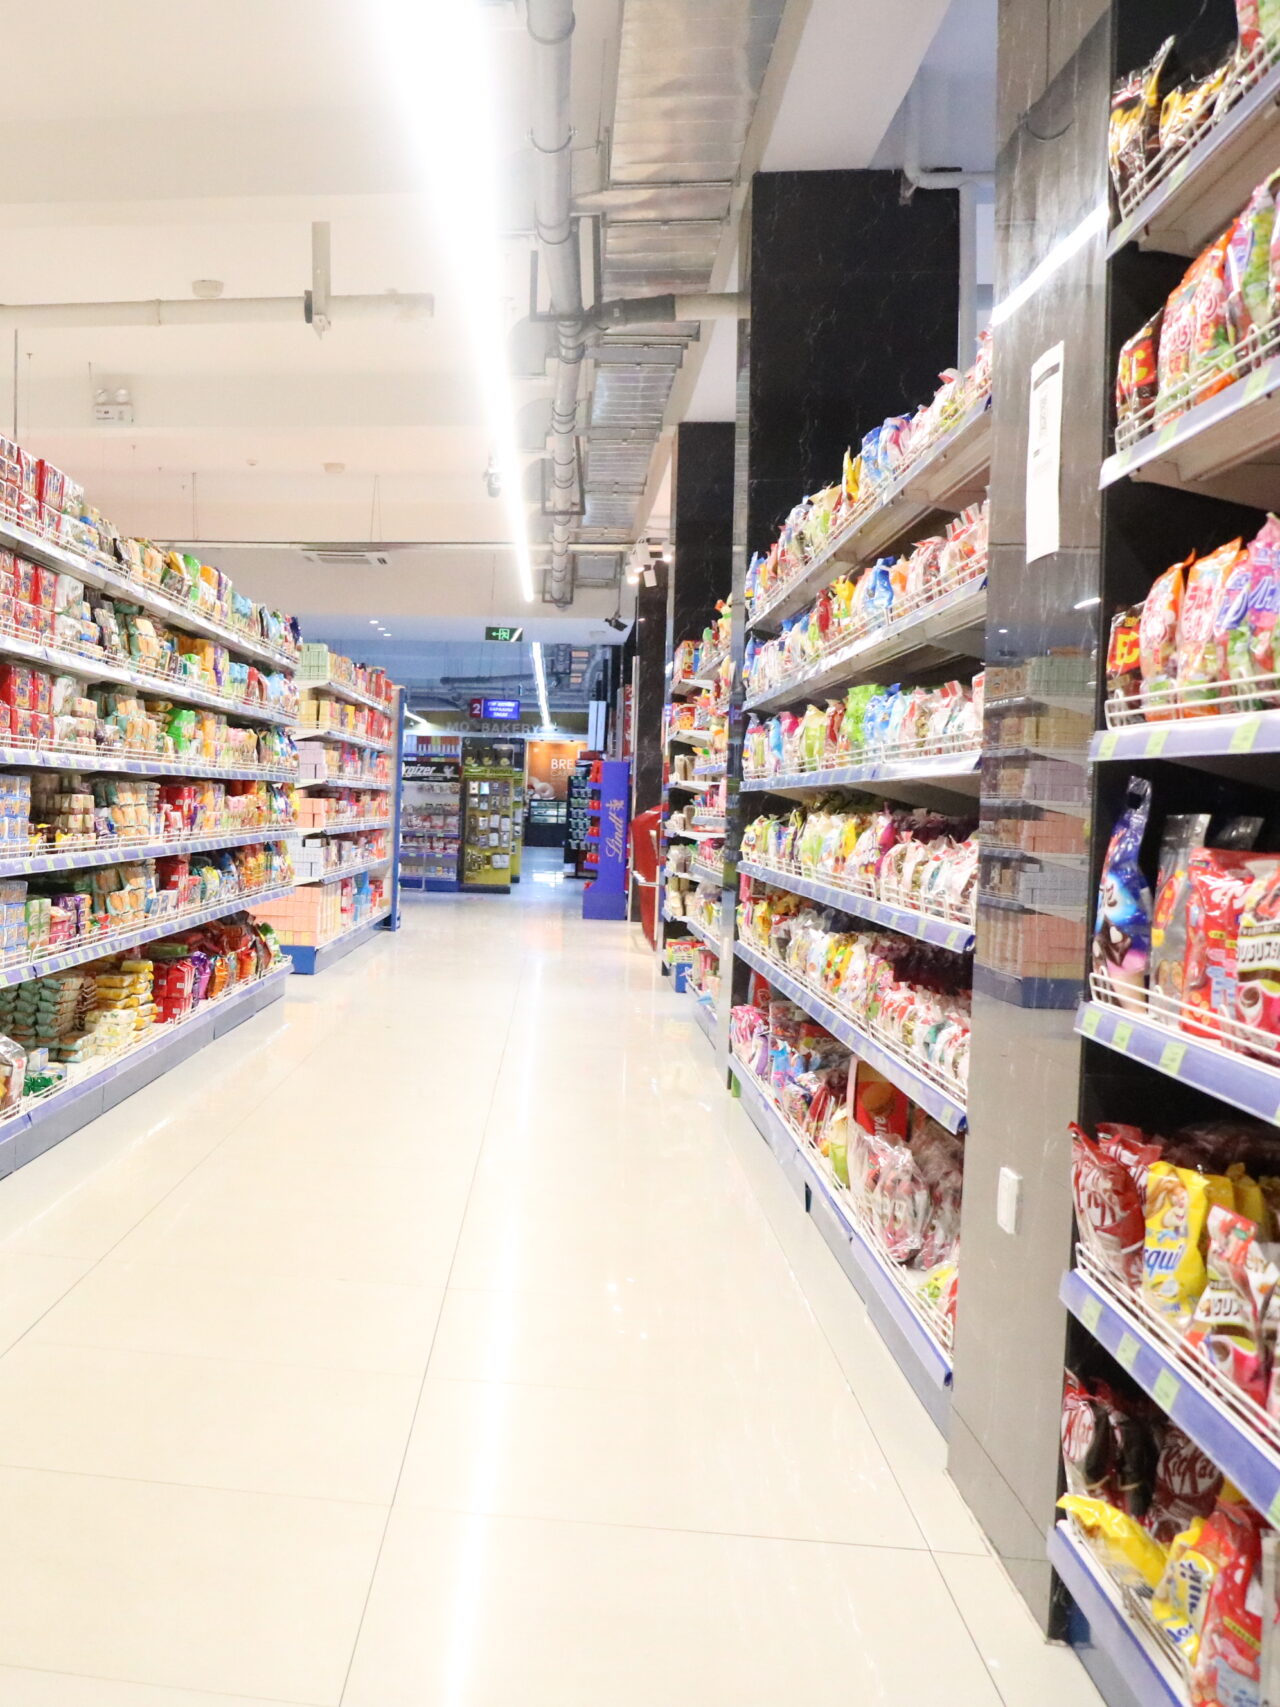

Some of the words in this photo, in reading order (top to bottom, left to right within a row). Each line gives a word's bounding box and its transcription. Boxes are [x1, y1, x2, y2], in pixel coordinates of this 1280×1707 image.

[472, 703, 481, 714] 2
[481, 722, 540, 735] BAKERY
[401, 764, 436, 778] rgizer
[551, 759, 575, 770] BRE
[605, 811, 624, 863] Lindt
